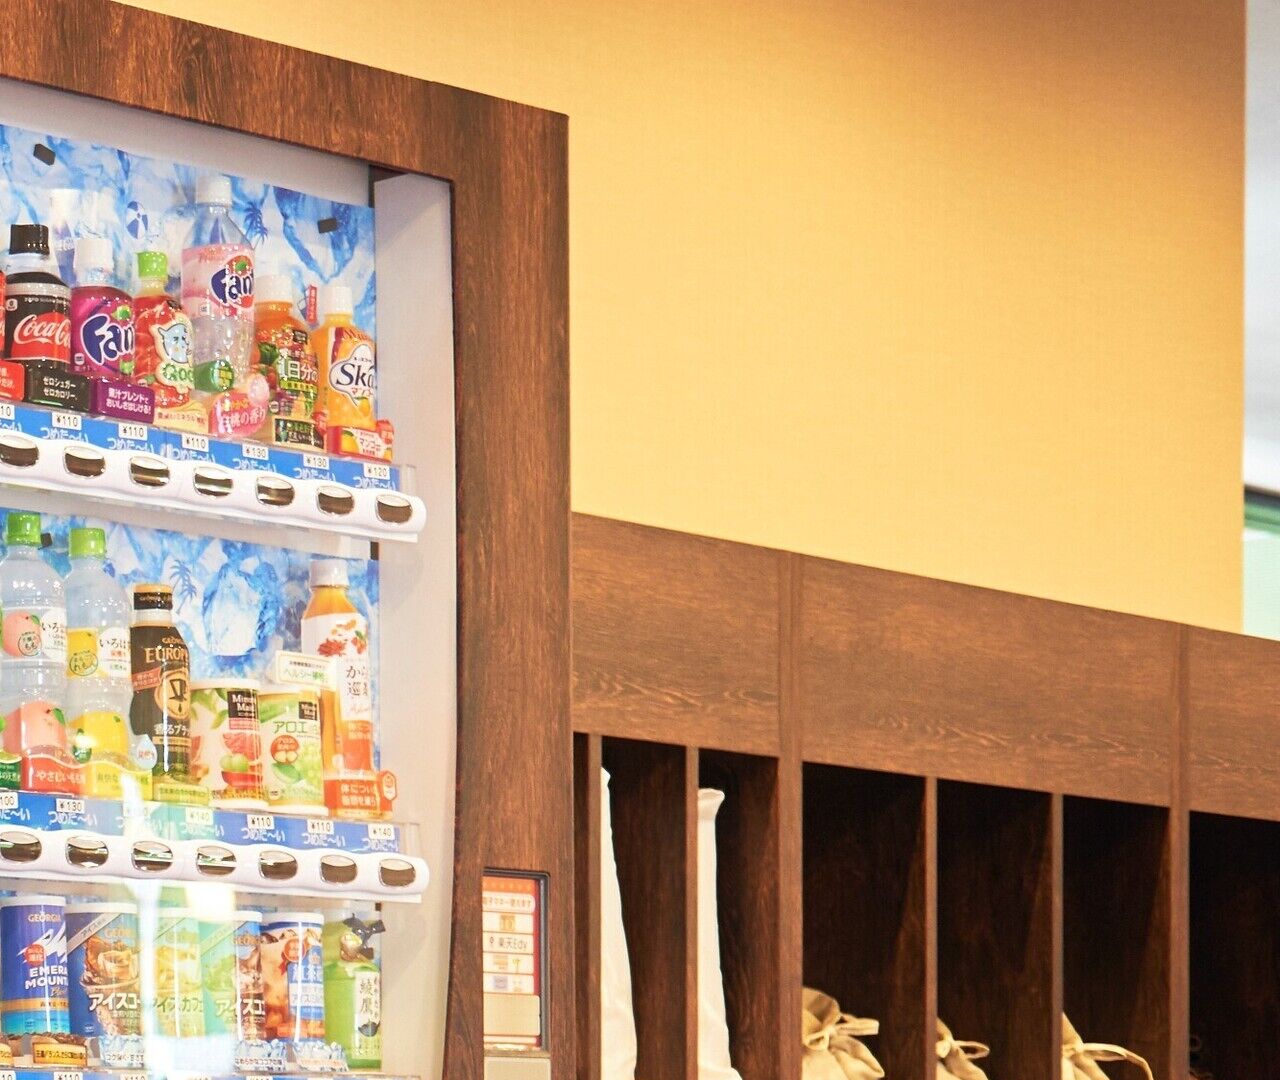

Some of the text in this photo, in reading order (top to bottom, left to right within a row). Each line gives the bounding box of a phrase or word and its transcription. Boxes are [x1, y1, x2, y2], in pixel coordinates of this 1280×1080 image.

[56, 416, 78, 428] ¥110
[123, 426, 145, 438] ¥110
[185, 437, 207, 449] ¥110
[272, 720, 308, 735] アロエ
[250, 816, 272, 828] ¥110
[311, 821, 331, 833] ¥110
